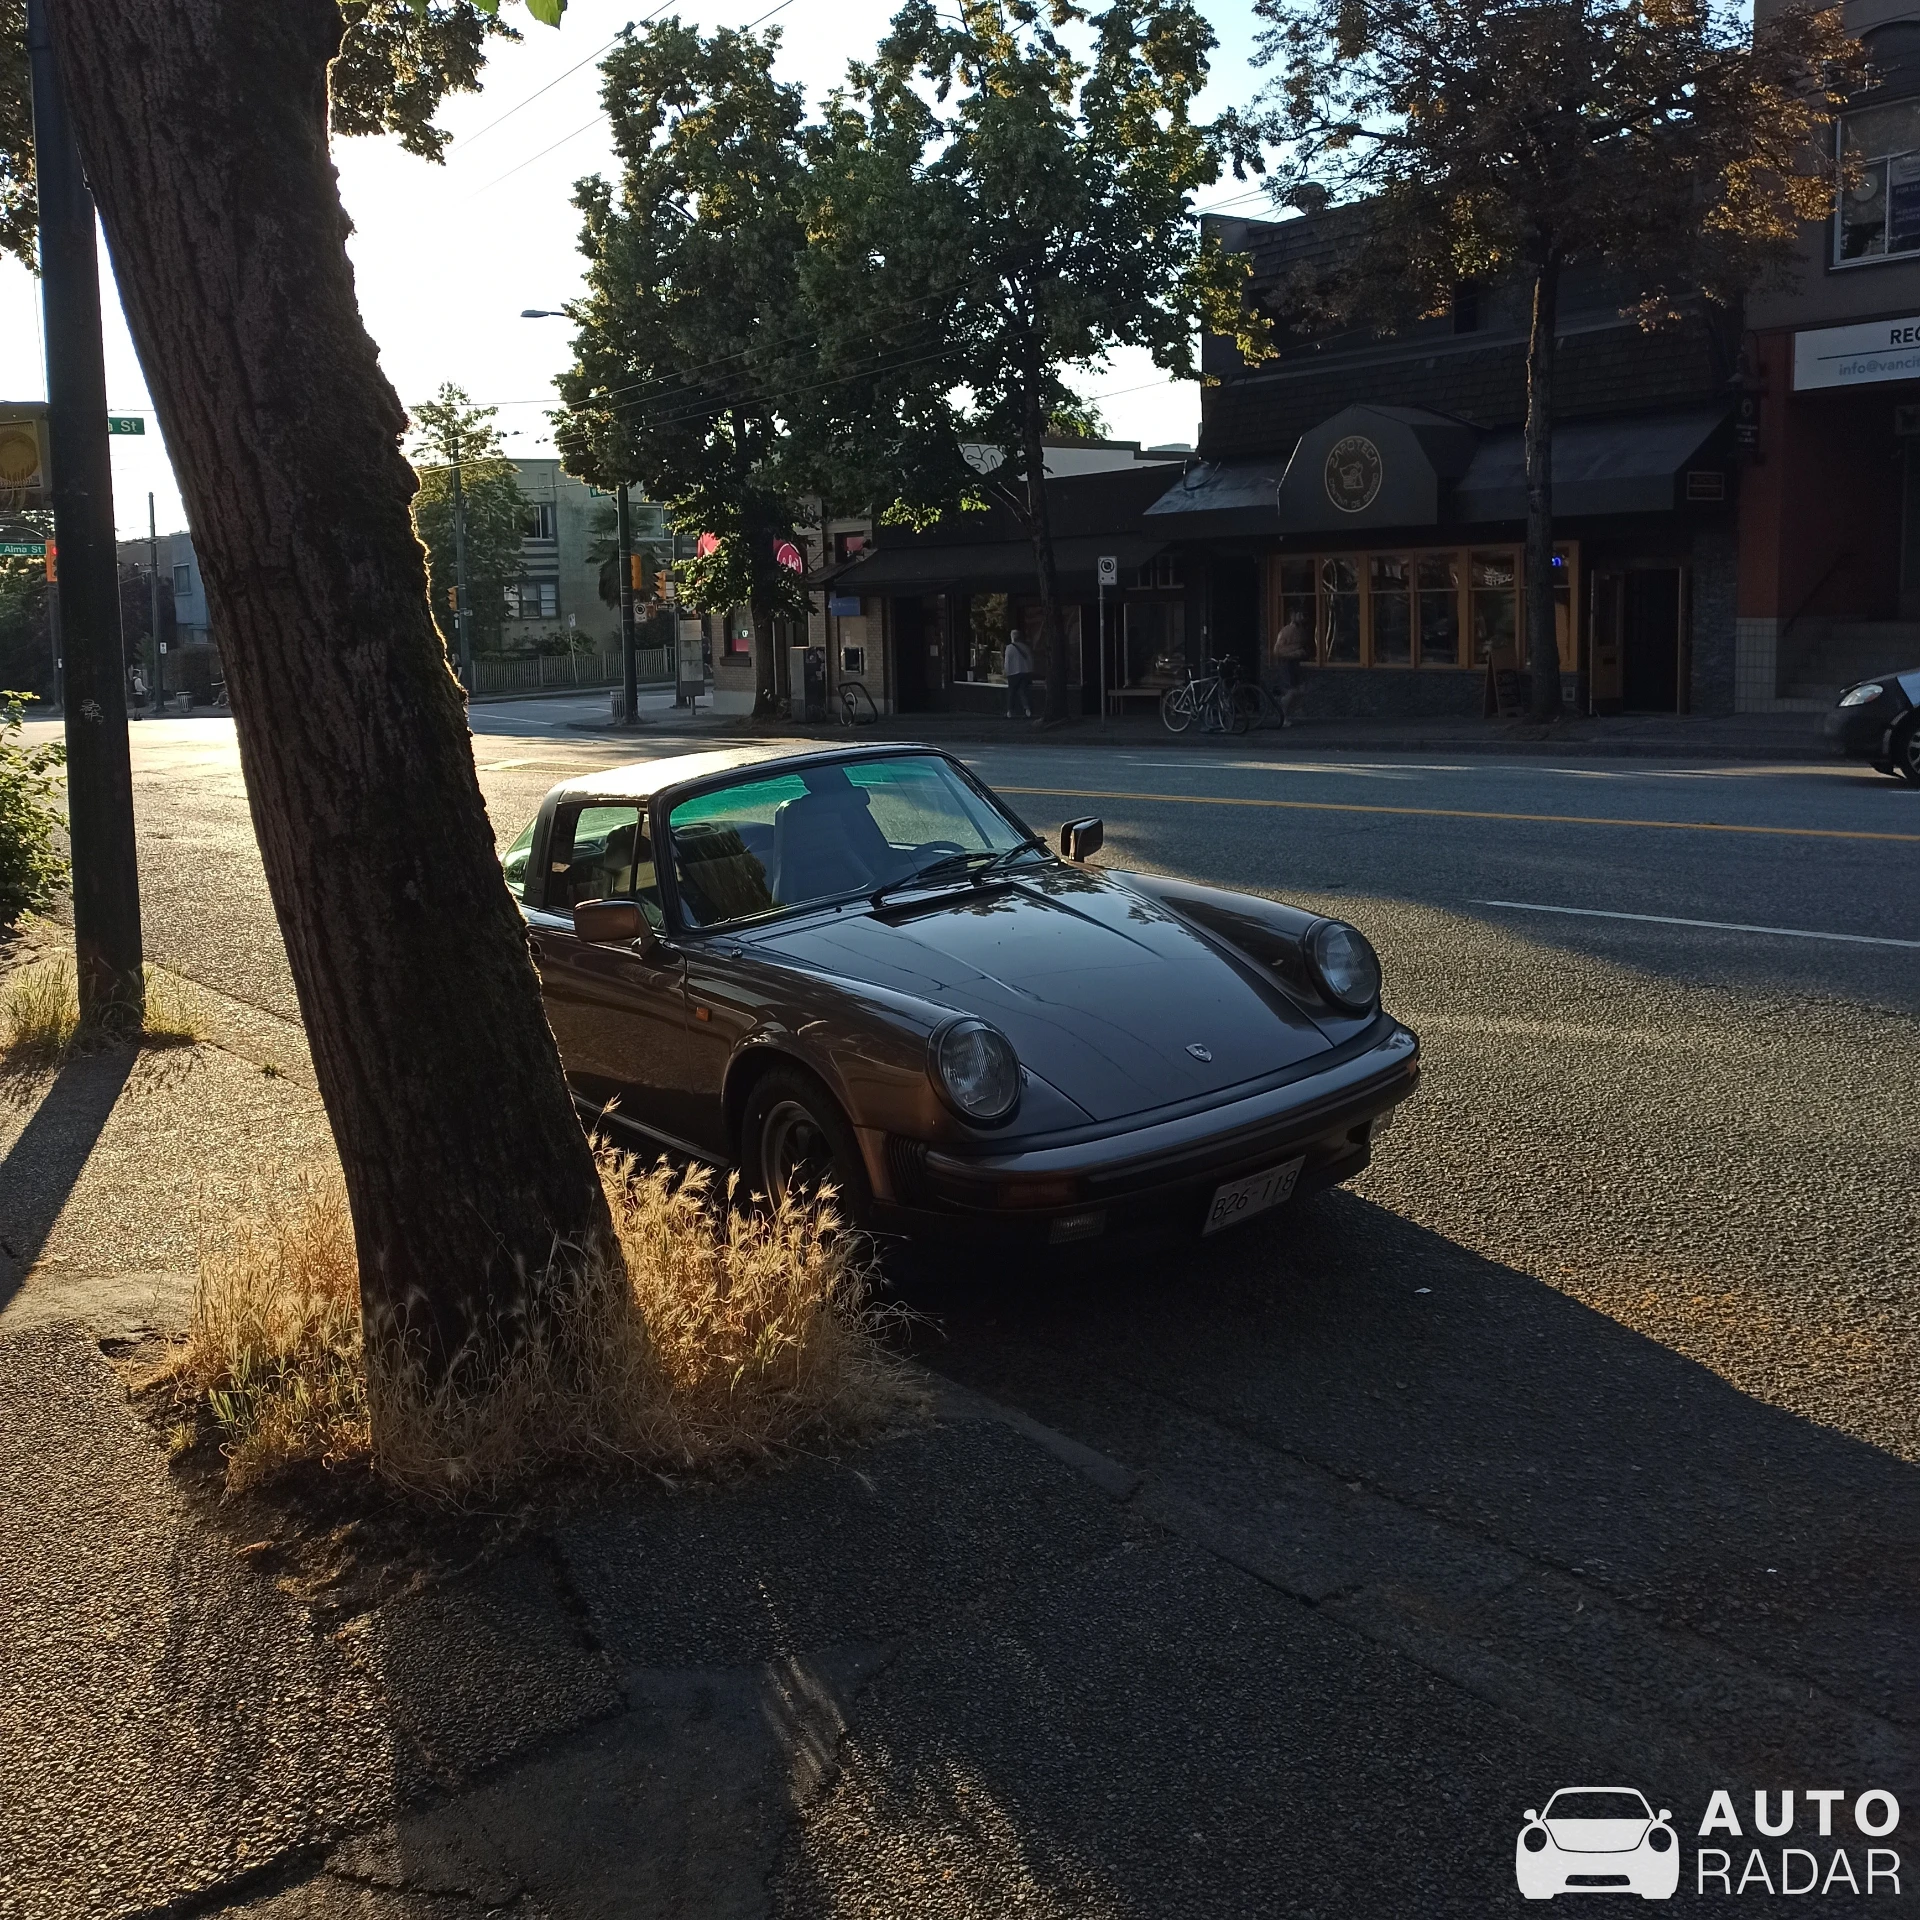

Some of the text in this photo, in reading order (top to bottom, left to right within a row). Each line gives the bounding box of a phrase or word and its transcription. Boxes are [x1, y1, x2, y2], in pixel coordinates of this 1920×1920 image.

[120, 420, 137, 433] St
[1329, 440, 1378, 469] ZAPOTECA
[4, 545, 43, 554] Alma St
